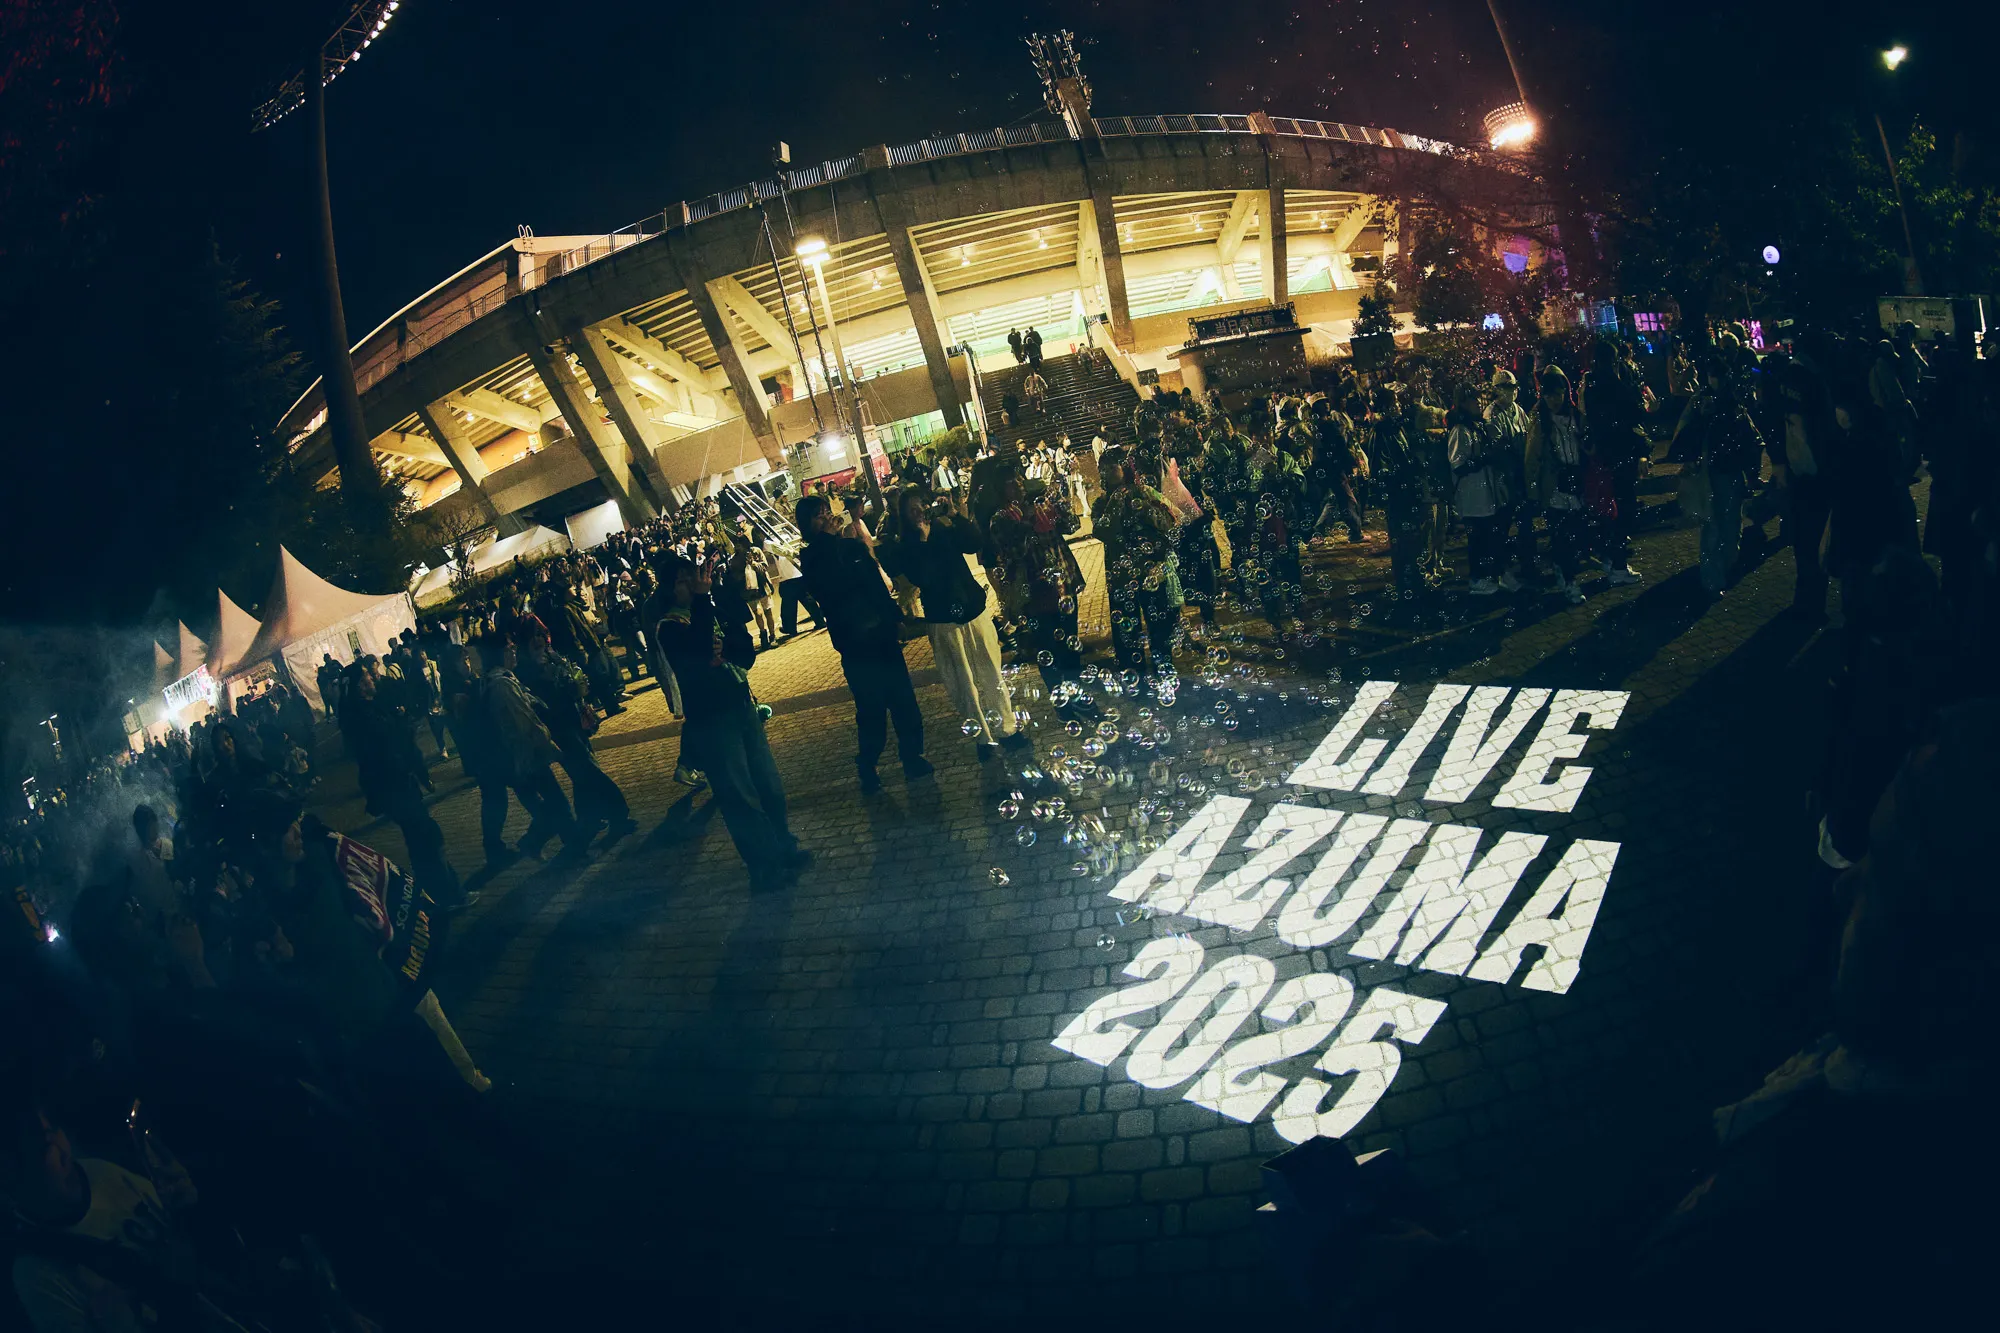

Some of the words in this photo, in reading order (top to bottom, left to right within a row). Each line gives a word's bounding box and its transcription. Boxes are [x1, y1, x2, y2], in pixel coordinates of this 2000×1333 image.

[1286, 680, 1631, 813] LIVE
[1107, 794, 1622, 995] AZUMA
[1050, 937, 1449, 1145] 2025
